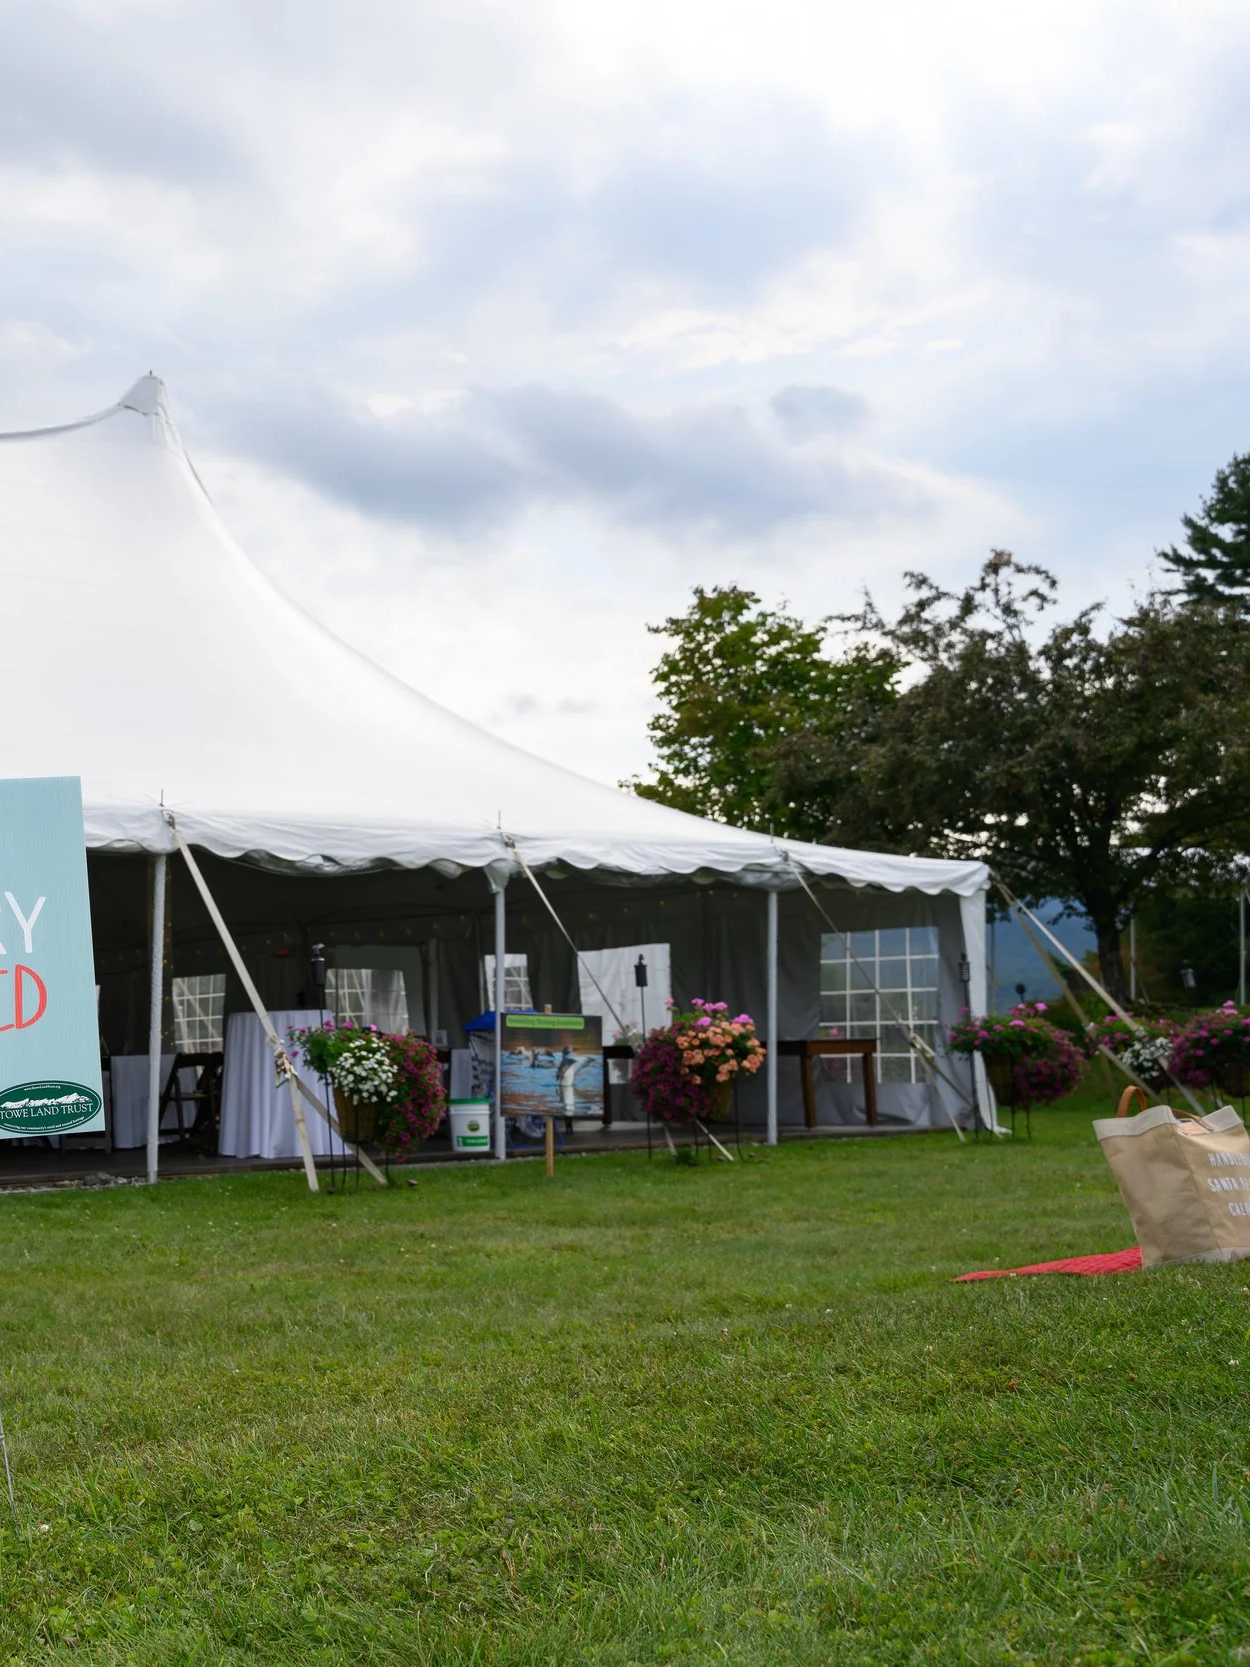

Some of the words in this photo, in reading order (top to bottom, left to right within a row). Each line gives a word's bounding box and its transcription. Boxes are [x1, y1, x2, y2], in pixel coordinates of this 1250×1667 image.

[31, 1106, 59, 1117] LAND
[61, 1103, 94, 1114] TRUST
[1207, 1177, 1239, 1192] SANTA
